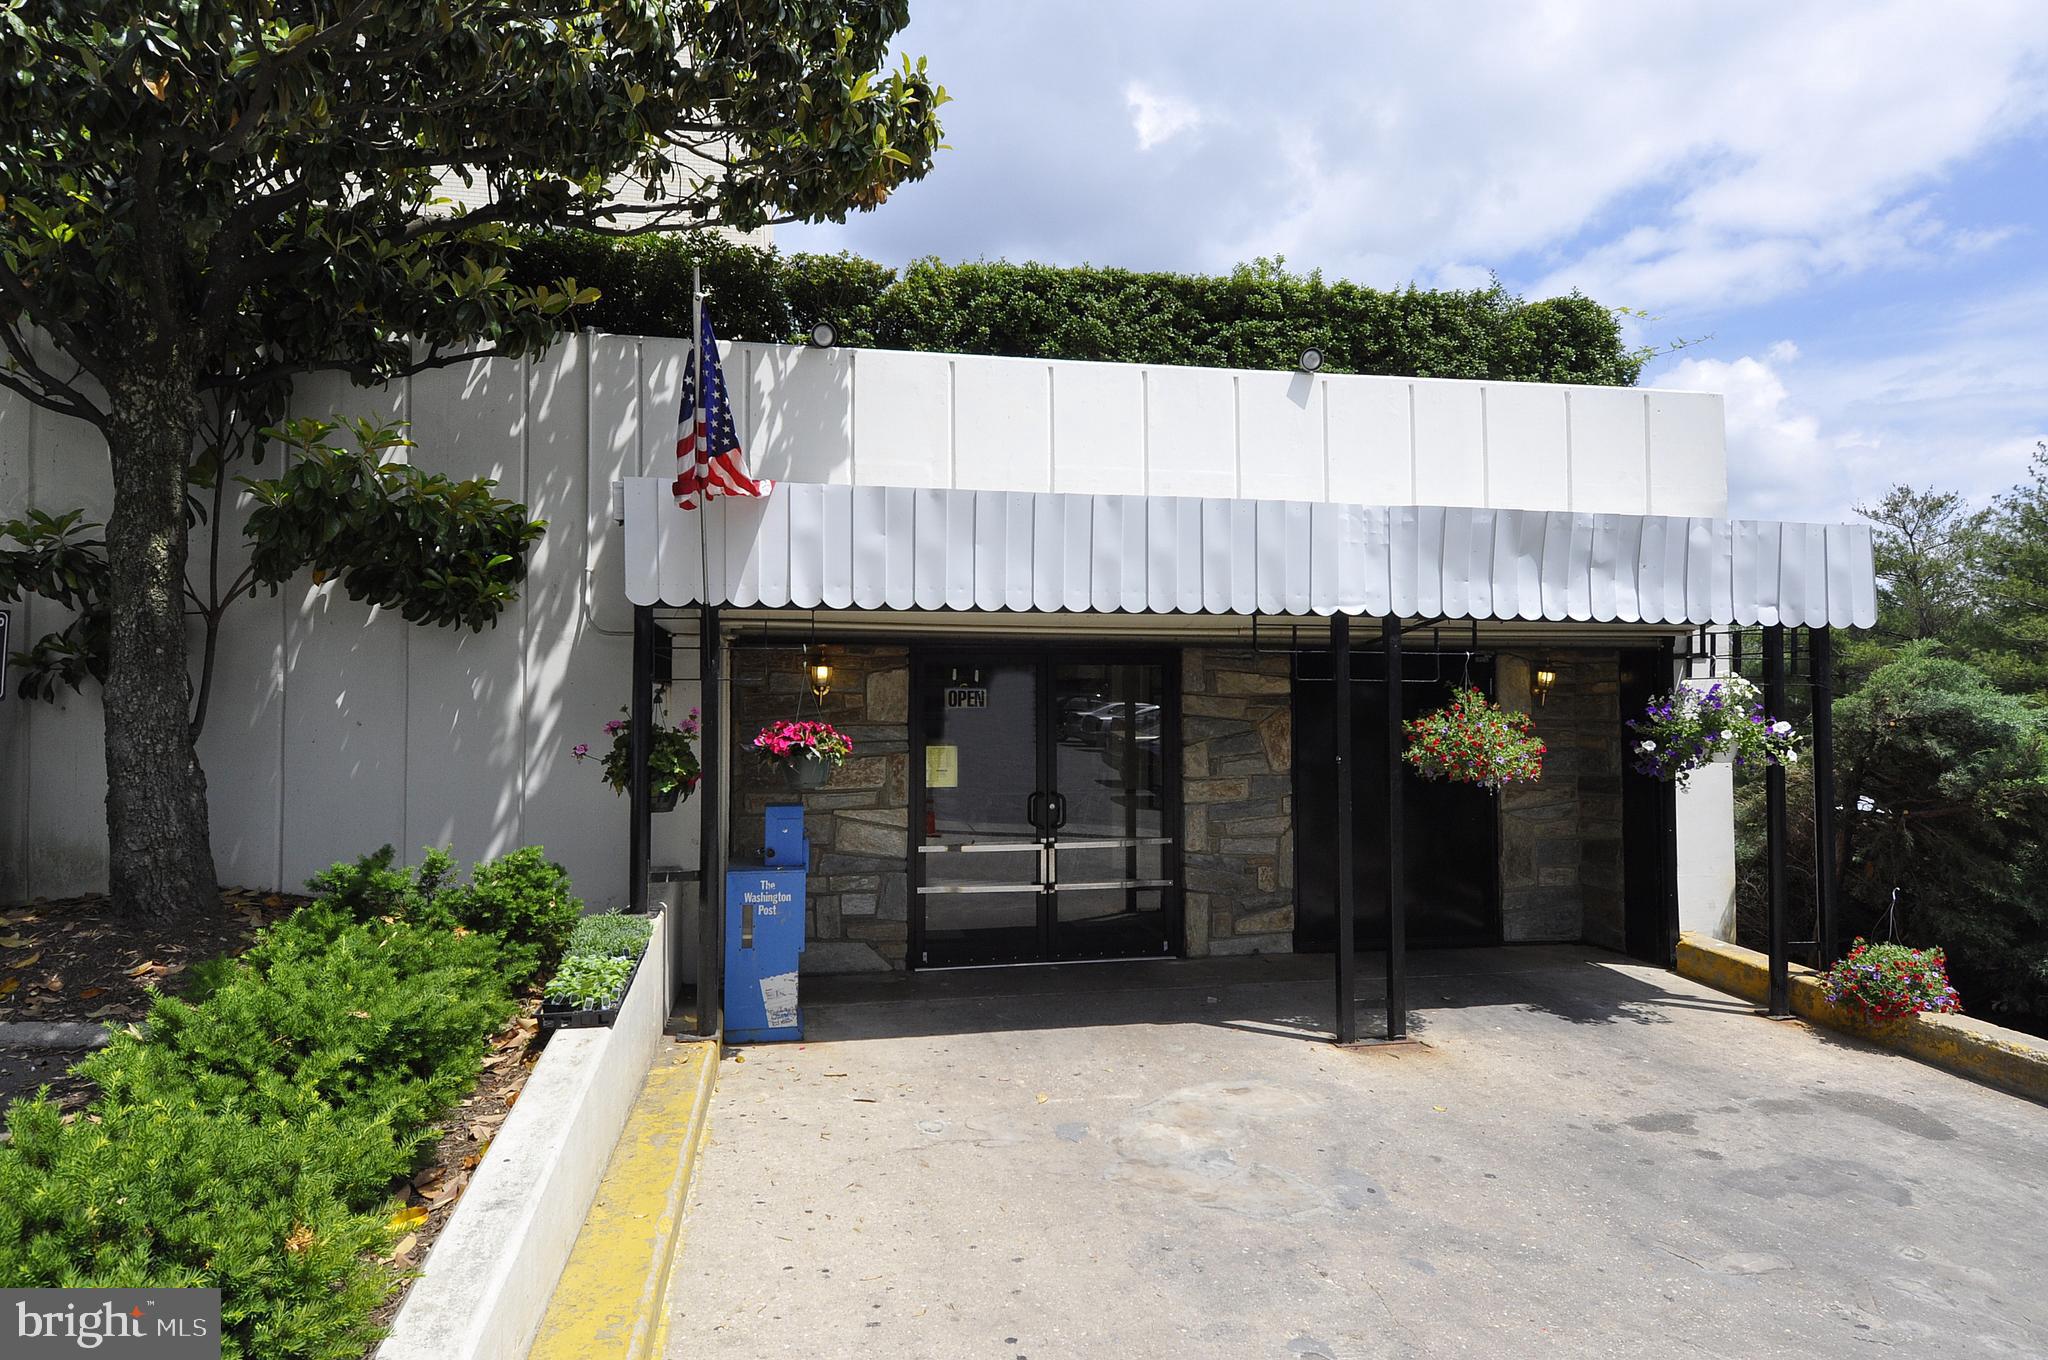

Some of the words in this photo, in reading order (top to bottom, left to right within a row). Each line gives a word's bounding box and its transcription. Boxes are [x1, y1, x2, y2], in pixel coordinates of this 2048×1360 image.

[948, 690, 985, 708] OPEN
[760, 880, 776, 890] The
[744, 892, 792, 905] Washington
[758, 905, 777, 916] Post
